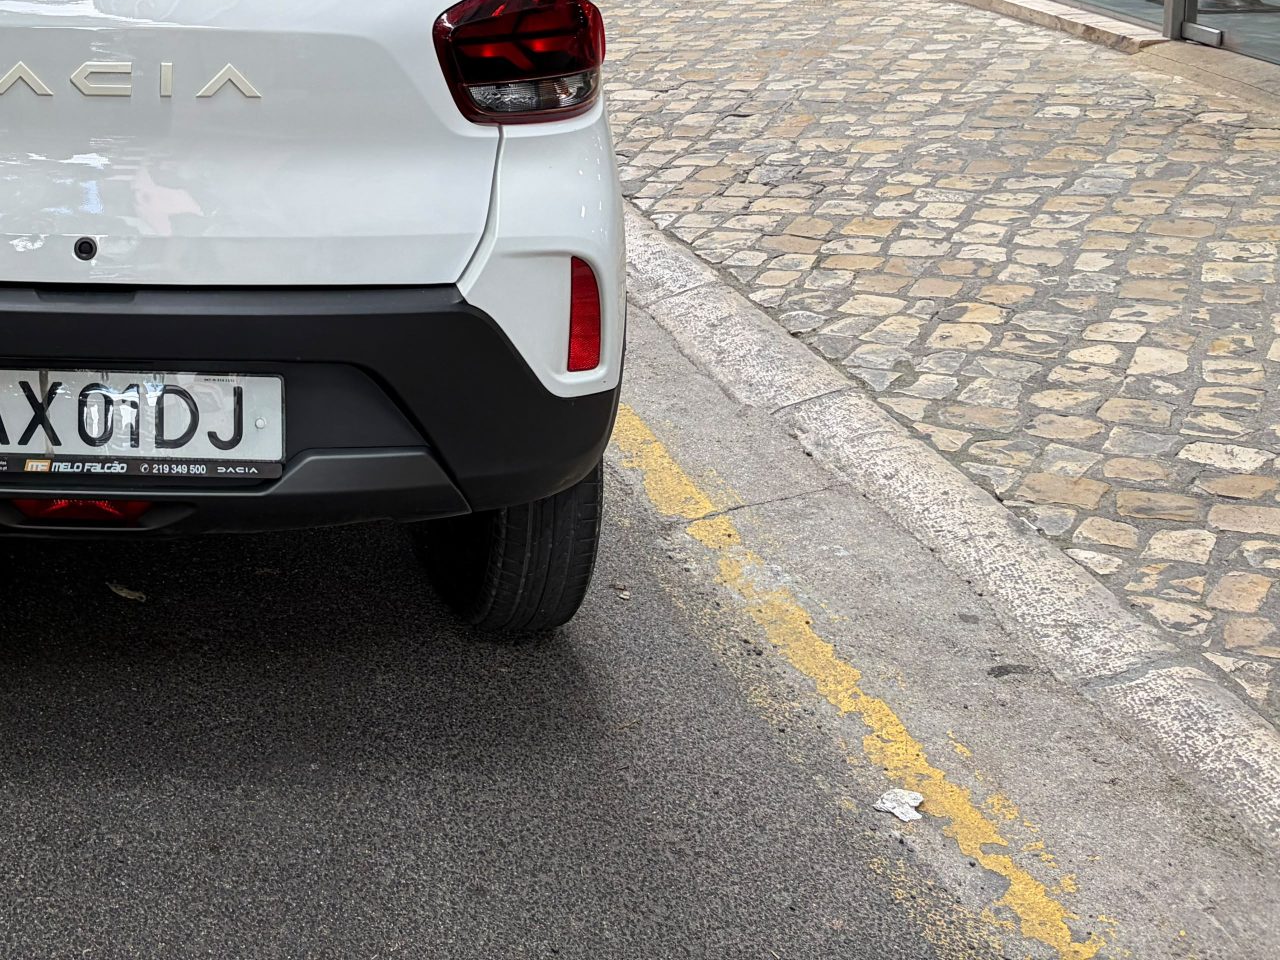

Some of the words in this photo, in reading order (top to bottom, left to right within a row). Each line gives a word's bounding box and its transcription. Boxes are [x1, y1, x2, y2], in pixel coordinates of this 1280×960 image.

[152, 464, 169, 474] 219
[171, 464, 188, 474] 349
[189, 465, 207, 475] 500
[217, 466, 259, 474] DACIA
